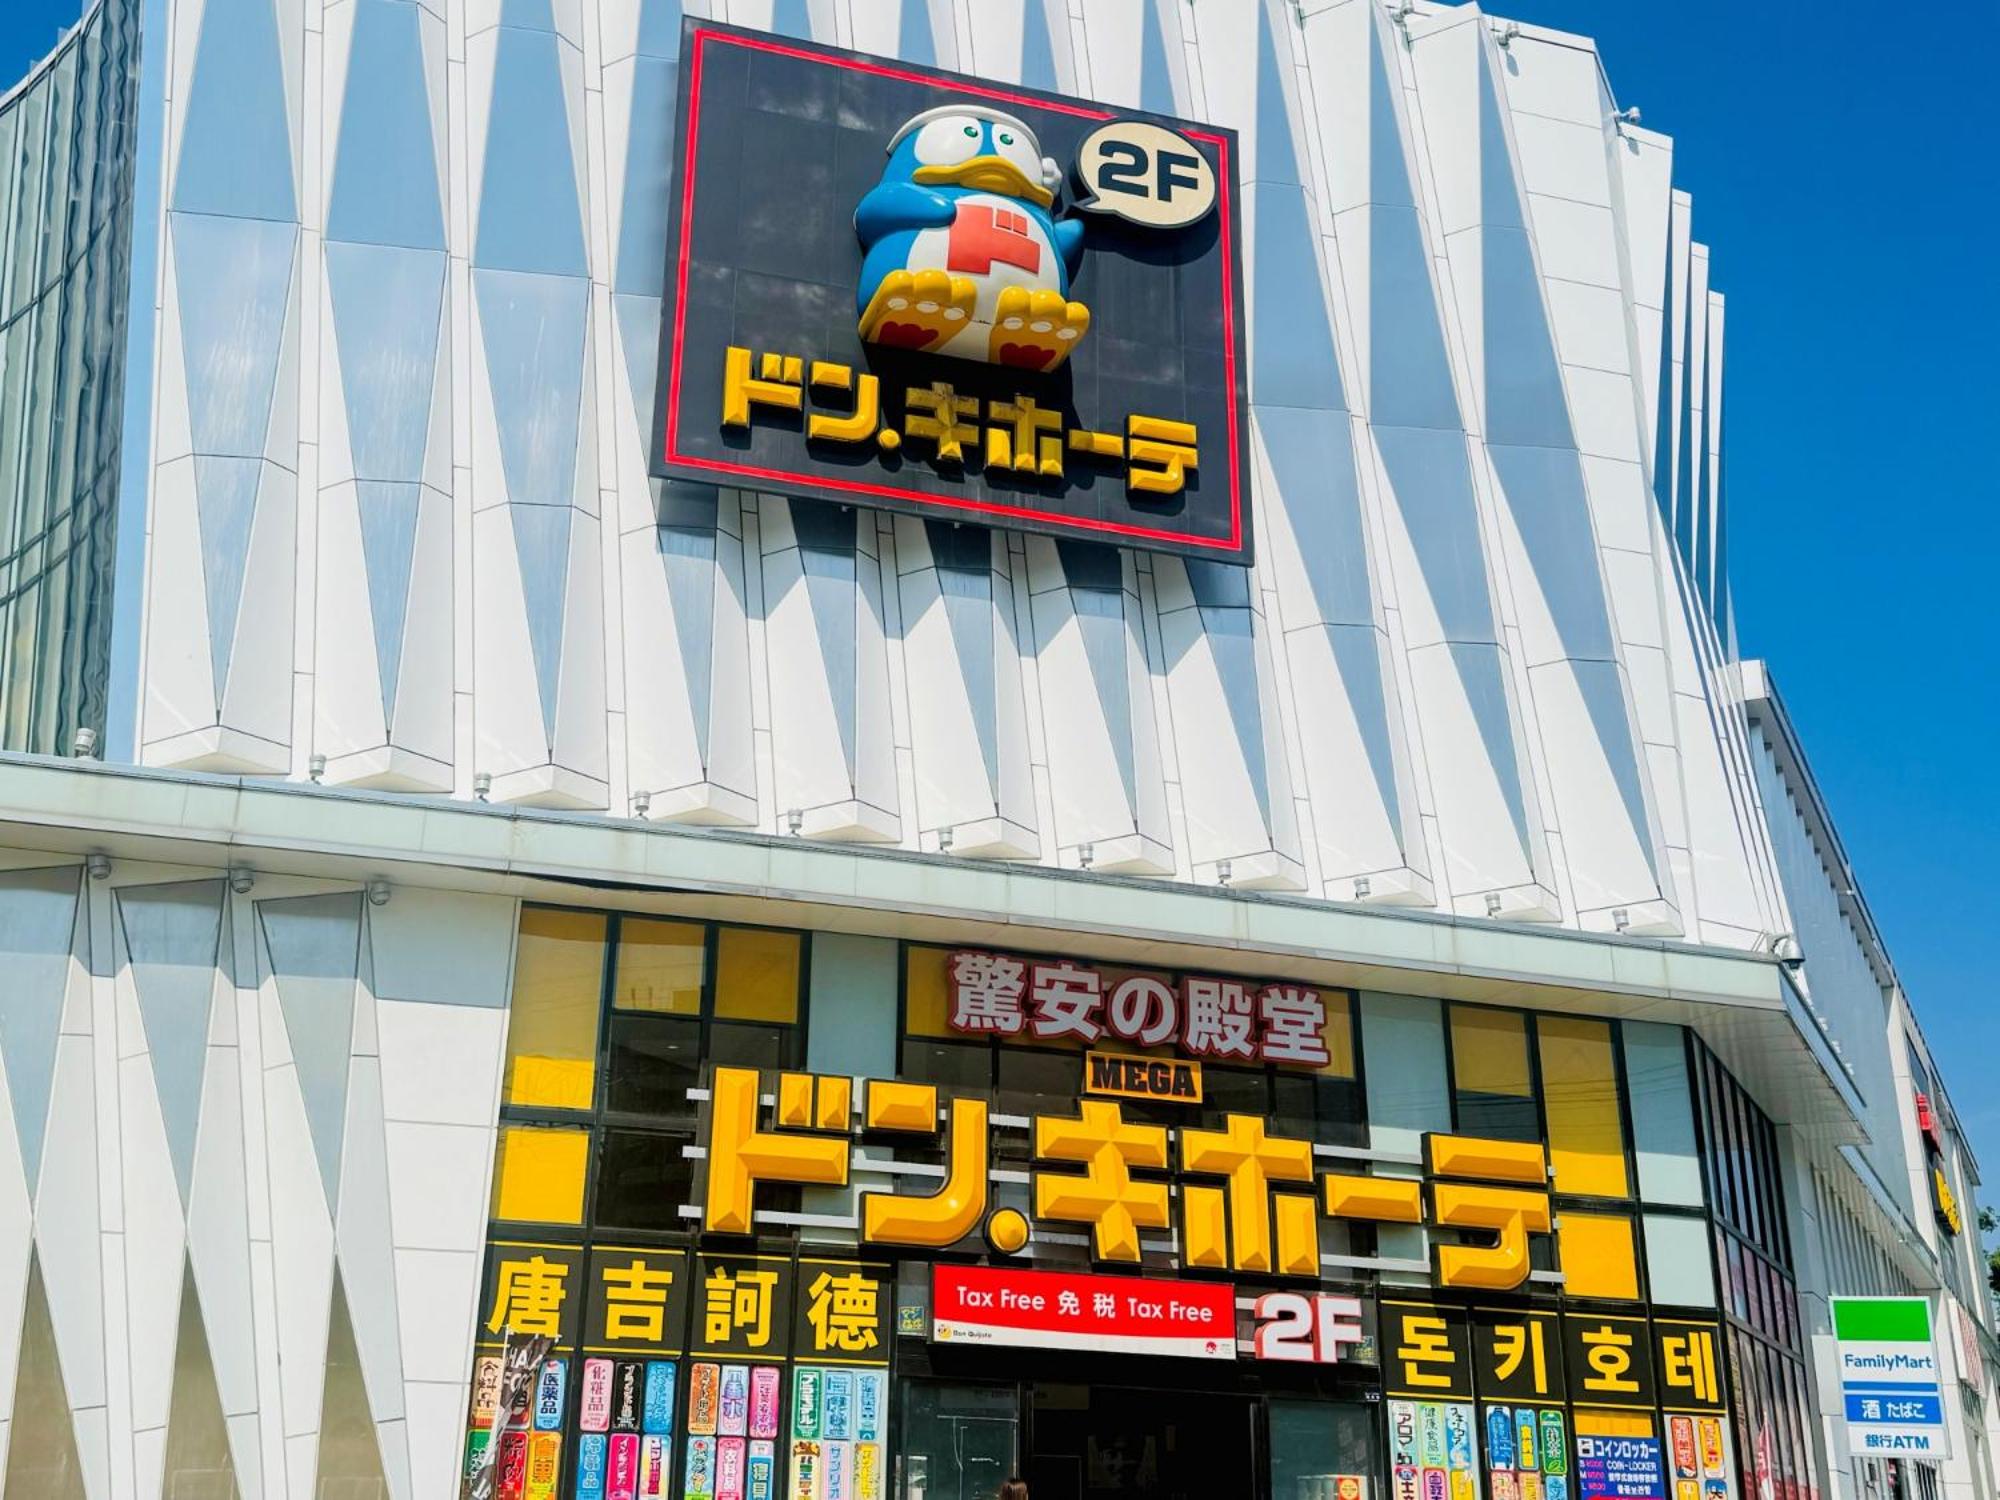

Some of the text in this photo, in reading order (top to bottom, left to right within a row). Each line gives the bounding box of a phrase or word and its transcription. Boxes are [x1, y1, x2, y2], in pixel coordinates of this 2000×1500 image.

[1097, 140, 1199, 202] 2F
[950, 950, 1330, 1067] 驚安の殿堂
[1092, 1056, 1196, 1098] MEGA
[957, 1286, 993, 1307] Tax
[1000, 1289, 1045, 1311] Free
[1127, 1297, 1163, 1319] Tax
[1170, 1300, 1213, 1322] Free
[1253, 1292, 1363, 1363] 2F
[1844, 1353, 1932, 1371] FamilyMart
[540, 1373, 560, 1414] 医薬品
[588, 1366, 605, 1411] 化粧品
[1861, 1399, 1926, 1419] 酒 たばこ
[1397, 1413, 1412, 1446] アロマ
[1864, 1434, 1930, 1450] 銀行ATM
[1595, 1440, 1658, 1459] コインロッカー
[1606, 1460, 1657, 1472] COIN-LOCKER
